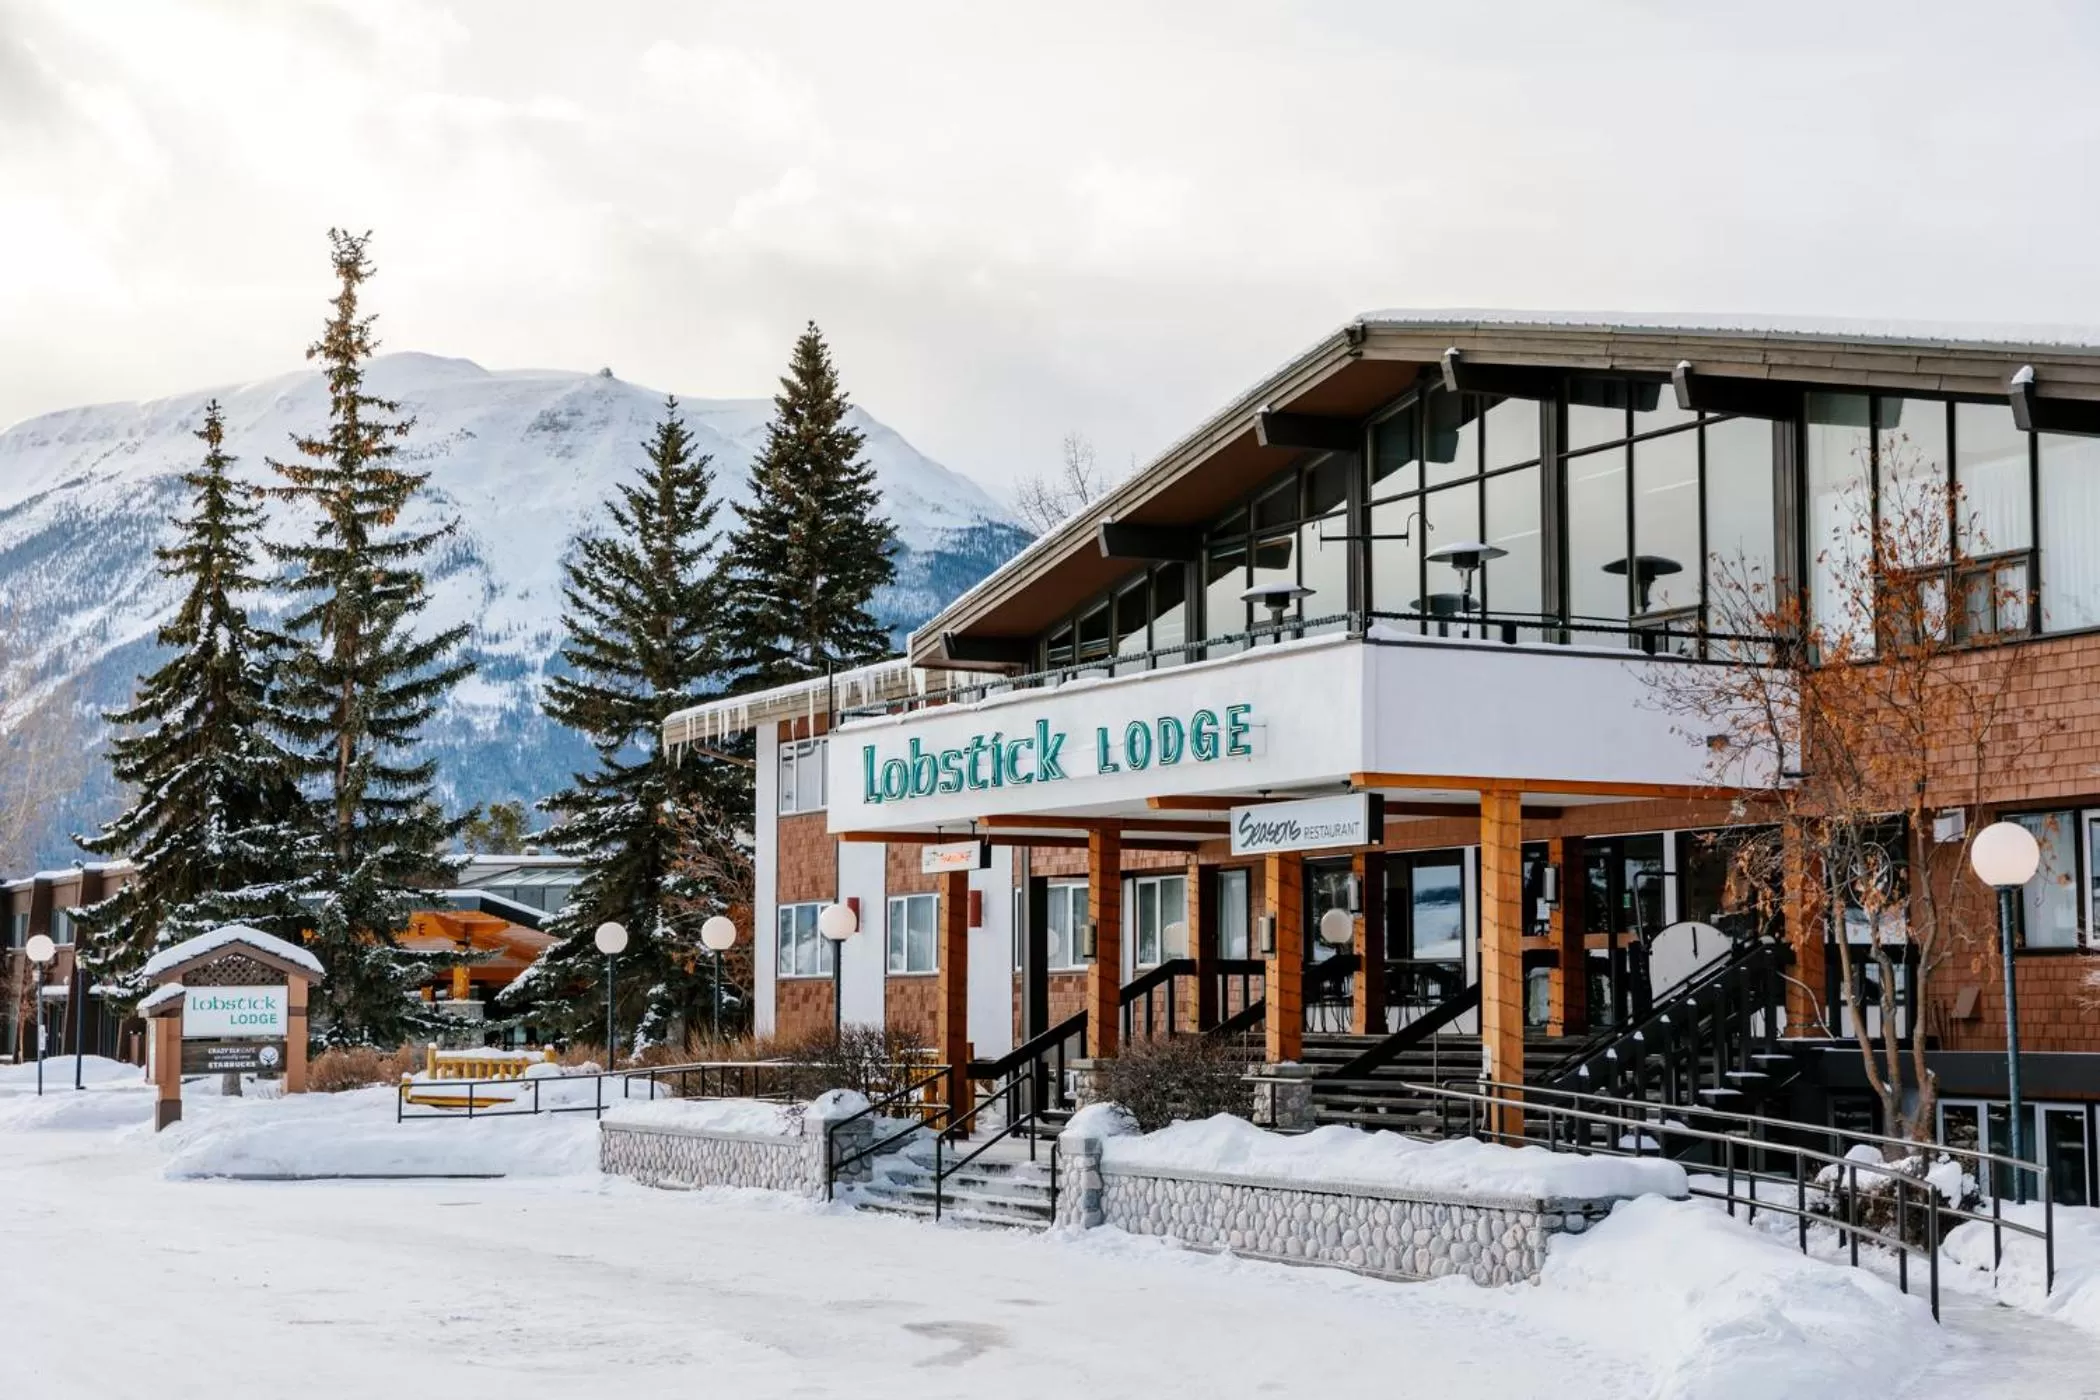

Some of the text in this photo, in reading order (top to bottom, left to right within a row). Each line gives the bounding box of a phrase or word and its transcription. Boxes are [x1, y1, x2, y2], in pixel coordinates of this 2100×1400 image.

[863, 704, 1252, 804] Lobstick LODGE
[1238, 812, 1361, 848] Seasons RESTAURANT
[192, 996, 277, 1011] Lobstick
[230, 1013, 278, 1025] LODGE
[208, 1061, 256, 1069] STARBUCKS
